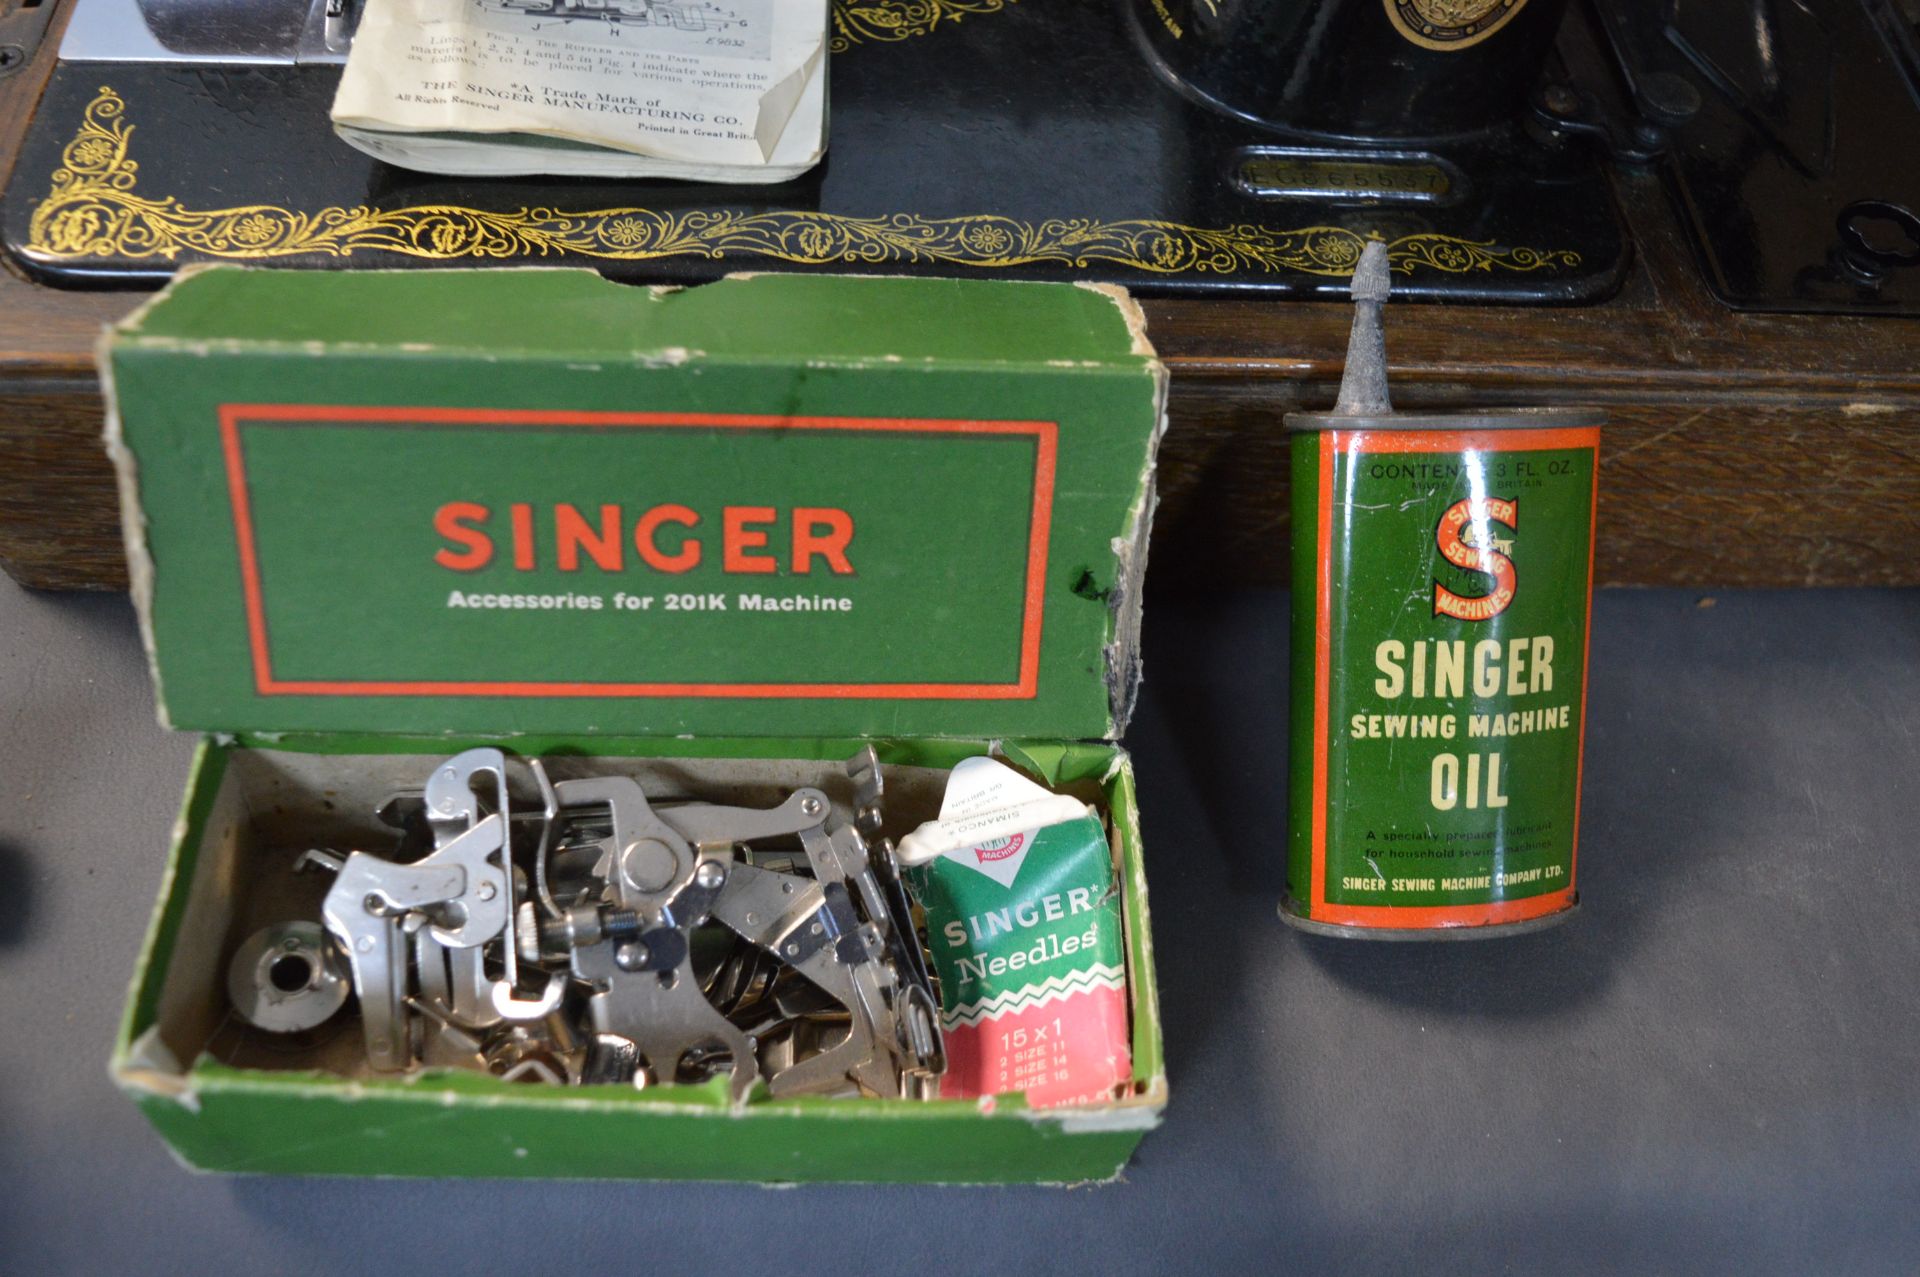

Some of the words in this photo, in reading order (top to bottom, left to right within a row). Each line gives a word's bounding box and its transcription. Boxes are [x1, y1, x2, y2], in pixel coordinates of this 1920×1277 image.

[610, 29, 620, 37] H
[406, 54, 423, 62] as
[410, 45, 467, 54] material
[477, 50, 489, 60] is
[498, 55, 513, 64] to
[523, 57, 539, 66] be
[549, 59, 593, 73] placed
[603, 65, 622, 76] for
[633, 70, 683, 83] various
[535, 49, 560, 60] and
[579, 55, 592, 64] in
[643, 61, 697, 75] indicate
[702, 67, 742, 80] where
[746, 70, 768, 81] the
[395, 93, 411, 101] All
[414, 95, 447, 105] Rights
[451, 95, 500, 111] Reserved
[421, 81, 458, 90] THE
[465, 83, 535, 103] SINGER
[544, 97, 705, 122] MANUFACTURING
[713, 116, 743, 126] CO.
[541, 86, 587, 100] Trade
[597, 92, 638, 105] Mark
[646, 98, 661, 107] of
[637, 122, 675, 134] Printed
[679, 127, 689, 135] in
[693, 129, 722, 138] Great
[1496, 464, 1506, 476] 3
[1548, 460, 1575, 475] OZ.
[1497, 480, 1543, 489] BRITAIN
[433, 502, 856, 576] SINGER
[447, 591, 604, 611] Accessories
[613, 592, 651, 610] for
[664, 593, 727, 611] 201K
[738, 593, 853, 612] Machine
[1437, 589, 1511, 617] MACHINES
[1374, 635, 1555, 699] SINGER
[1350, 714, 1456, 740] SEWING
[1468, 705, 1570, 738] MACHINE
[1430, 752, 1509, 812] OIL
[981, 836, 1022, 860] MACHINES
[1366, 831, 1377, 840] A
[1383, 830, 1439, 842] specially
[1366, 848, 1382, 858] for
[1389, 847, 1454, 859] household
[1342, 876, 1386, 891] SINGER
[1391, 877, 1436, 891] SEWING
[1441, 875, 1491, 891] MACHINE
[1495, 869, 1541, 887] COMPANY
[1545, 864, 1564, 878] LTD.
[1001, 1028, 1028, 1052] 15
[1052, 1017, 1062, 1036] 1
[1000, 1056, 1008, 1068] 2
[1014, 1045, 1046, 1063] SIZE
[1053, 1040, 1065, 1052] 11
[1000, 1071, 1008, 1082] 2
[1014, 1059, 1047, 1077] SIZE
[1053, 1055, 1067, 1066] 14
[1014, 1073, 1048, 1091] SIZE
[1053, 1069, 1069, 1082] 16
